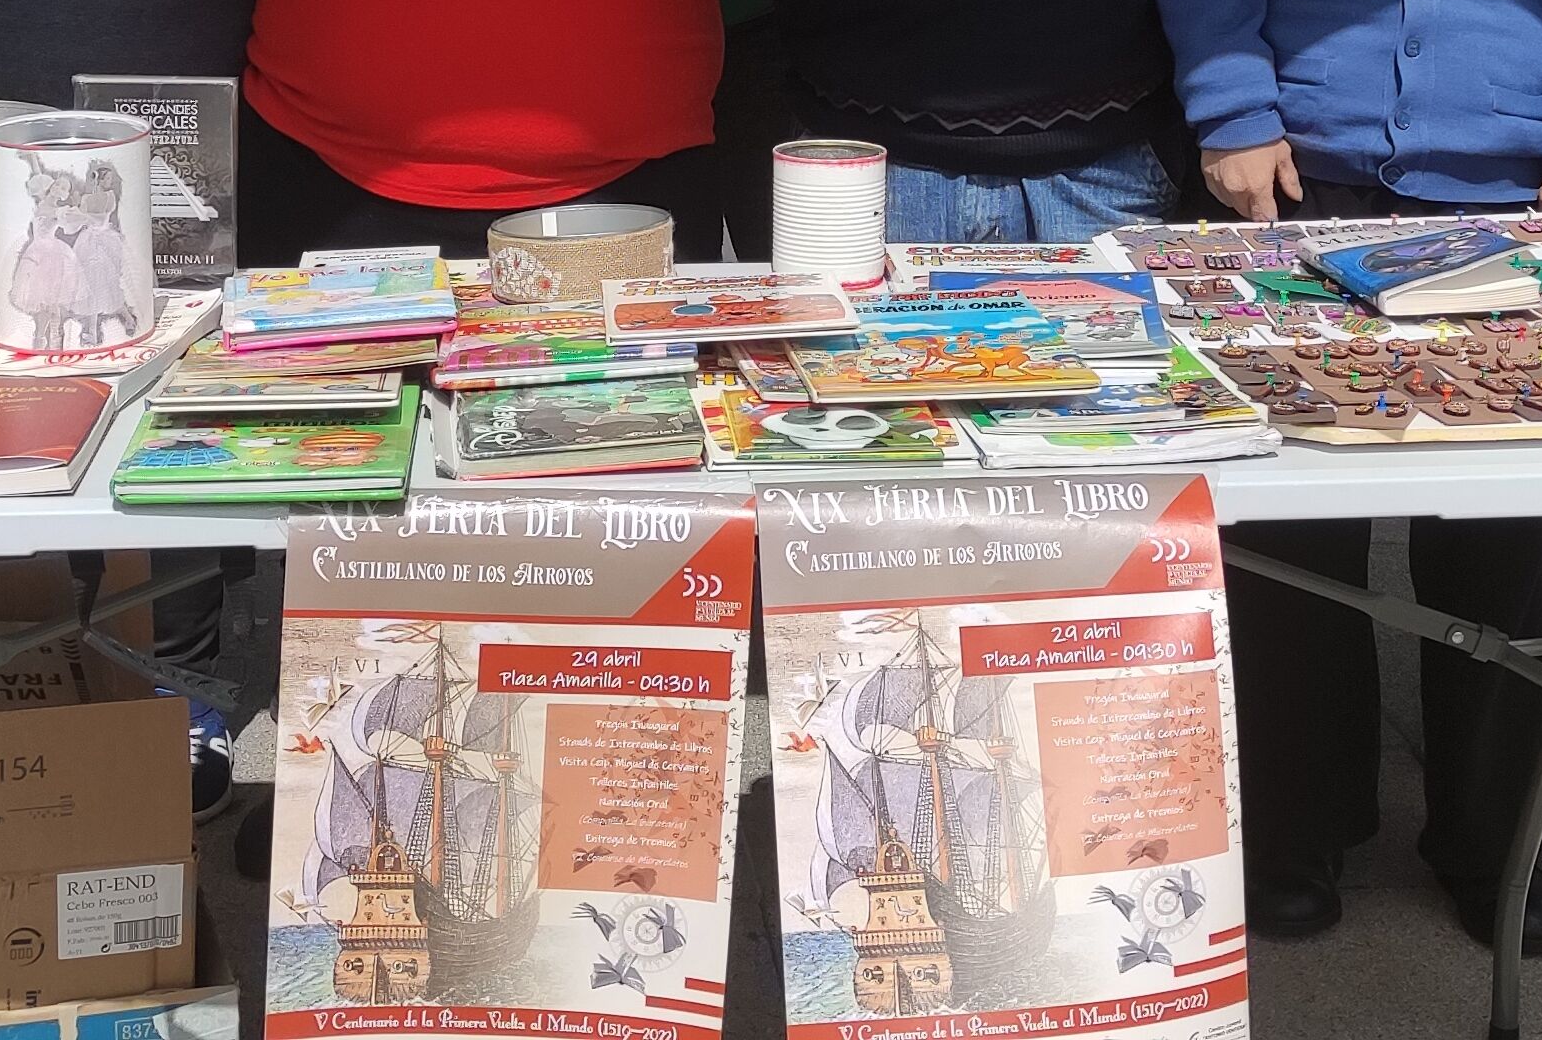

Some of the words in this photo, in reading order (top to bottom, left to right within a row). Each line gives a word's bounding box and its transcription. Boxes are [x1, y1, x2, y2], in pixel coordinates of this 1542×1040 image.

[114, 103, 138, 116] LOS
[140, 103, 198, 116] GRANDES
[146, 115, 198, 130] ICALES
[150, 135, 199, 145] ITERATURA
[155, 255, 201, 265] RENINA
[205, 255, 215, 265] II
[763, 488, 851, 534] XIX
[864, 484, 978, 526] FERIA
[984, 485, 1045, 516] DEL
[1054, 479, 1149, 521] LIBRO
[398, 495, 508, 538] FERIA
[523, 503, 582, 538] DEL
[599, 497, 691, 550] LIBRO
[313, 546, 446, 583] CASTILBLANCO
[452, 564, 472, 582] DE
[477, 565, 506, 584] LOS
[512, 563, 594, 586] ARROYOS
[785, 540, 917, 578] CASTILBLANCO
[923, 547, 942, 566] DE
[948, 546, 976, 565] LOS
[982, 540, 1063, 565] ARROYOS
[1051, 625, 1077, 643] 29
[1083, 622, 1121, 640] abril
[571, 651, 597, 667] 29
[603, 650, 641, 667] abril
[982, 651, 1030, 669] Plaza
[1036, 646, 1106, 668] Amarilla
[1123, 642, 1176, 661] 09:30
[1181, 640, 1194, 656] h
[499, 669, 547, 687] Plaza
[551, 671, 622, 689] Amarilla
[639, 675, 693, 693] 09:30
[698, 676, 709, 693] h
[1088, 715, 1099, 725] de
[1163, 708, 1174, 718] de
[1177, 705, 1206, 717] Libros
[1053, 737, 1083, 747] Visita
[1110, 731, 1141, 745] Miguel
[1144, 729, 1156, 740] de
[1158, 725, 1207, 739] Cervantes
[594, 737, 606, 747] de
[670, 741, 682, 751] de
[684, 742, 713, 754] Libros
[1086, 754, 1127, 765] Talleres
[1129, 747, 1179, 763] Infantiles
[558, 757, 588, 767] Visita
[615, 759, 646, 772] Miguel
[647, 760, 659, 770] de
[662, 761, 710, 775] Cervantes
[589, 776, 628, 788] Talleres
[630, 779, 679, 791] Infantiles
[1100, 773, 1146, 784] Narración
[1148, 768, 1170, 779] Oral
[599, 798, 645, 809] Narración
[647, 799, 668, 809] Oral
[1091, 812, 1132, 824] Entrega
[1134, 809, 1145, 819] de
[1147, 806, 1184, 818] Premios
[585, 833, 625, 847] Entrega
[627, 834, 638, 844] de
[640, 836, 677, 849] Premios
[67, 874, 156, 896] RAT-END
[67, 901, 95, 911] Cebo
[99, 897, 135, 908] Fresco
[138, 892, 159, 904] 003
[314, 1012, 329, 1031] V
[332, 1012, 399, 1030] Centenario
[403, 1010, 418, 1028] de
[421, 1009, 434, 1028] la
[438, 1007, 487, 1029] Primera
[486, 1010, 526, 1031] Vuelta
[530, 1013, 542, 1031] al
[547, 1013, 594, 1034] Mundo
[838, 1025, 853, 1040] V
[859, 1024, 927, 1040] Centenario
[932, 1021, 947, 1039] de
[950, 1019, 963, 1038] la
[967, 1015, 1019, 1037] Primera
[1016, 1012, 1058, 1032] Vuelta
[1062, 1009, 1074, 1028] al
[1079, 1004, 1127, 1027] Mundo
